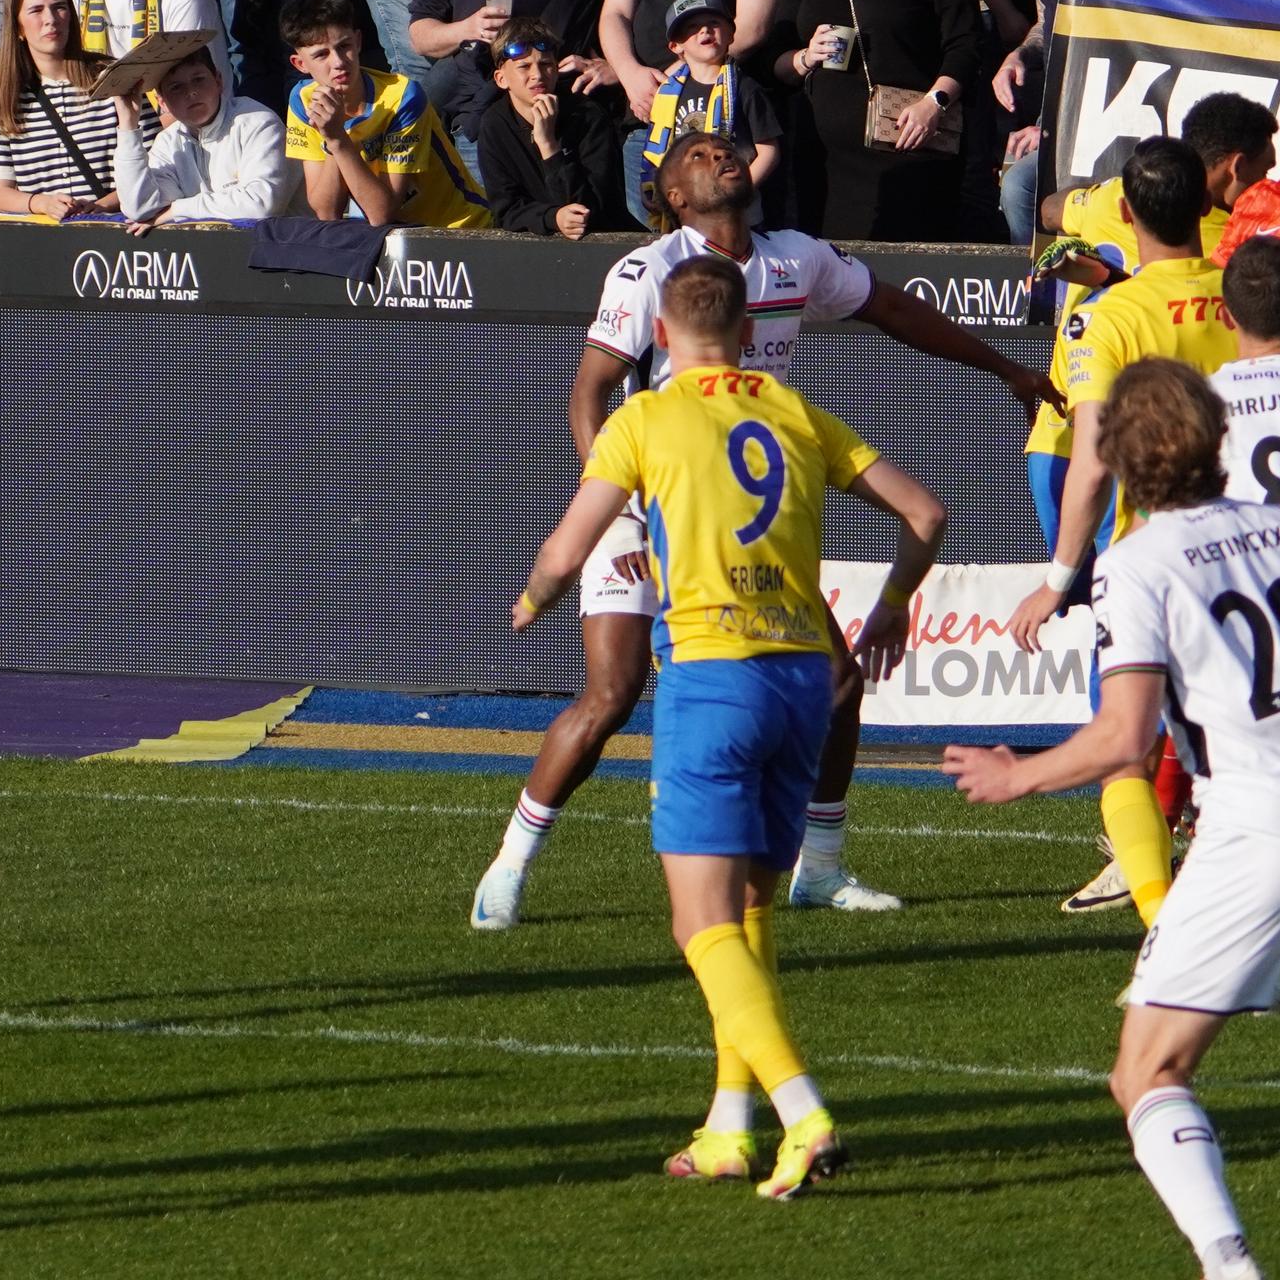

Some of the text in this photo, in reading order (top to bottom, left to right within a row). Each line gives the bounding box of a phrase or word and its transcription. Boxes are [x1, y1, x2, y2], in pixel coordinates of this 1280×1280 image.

[111, 250, 200, 288] ARMA
[385, 259, 474, 297] ARMA
[697, 371, 765, 398] 777
[727, 419, 787, 546] 9
[729, 564, 786, 594] FRIGAN
[904, 647, 1087, 696] LOMM
